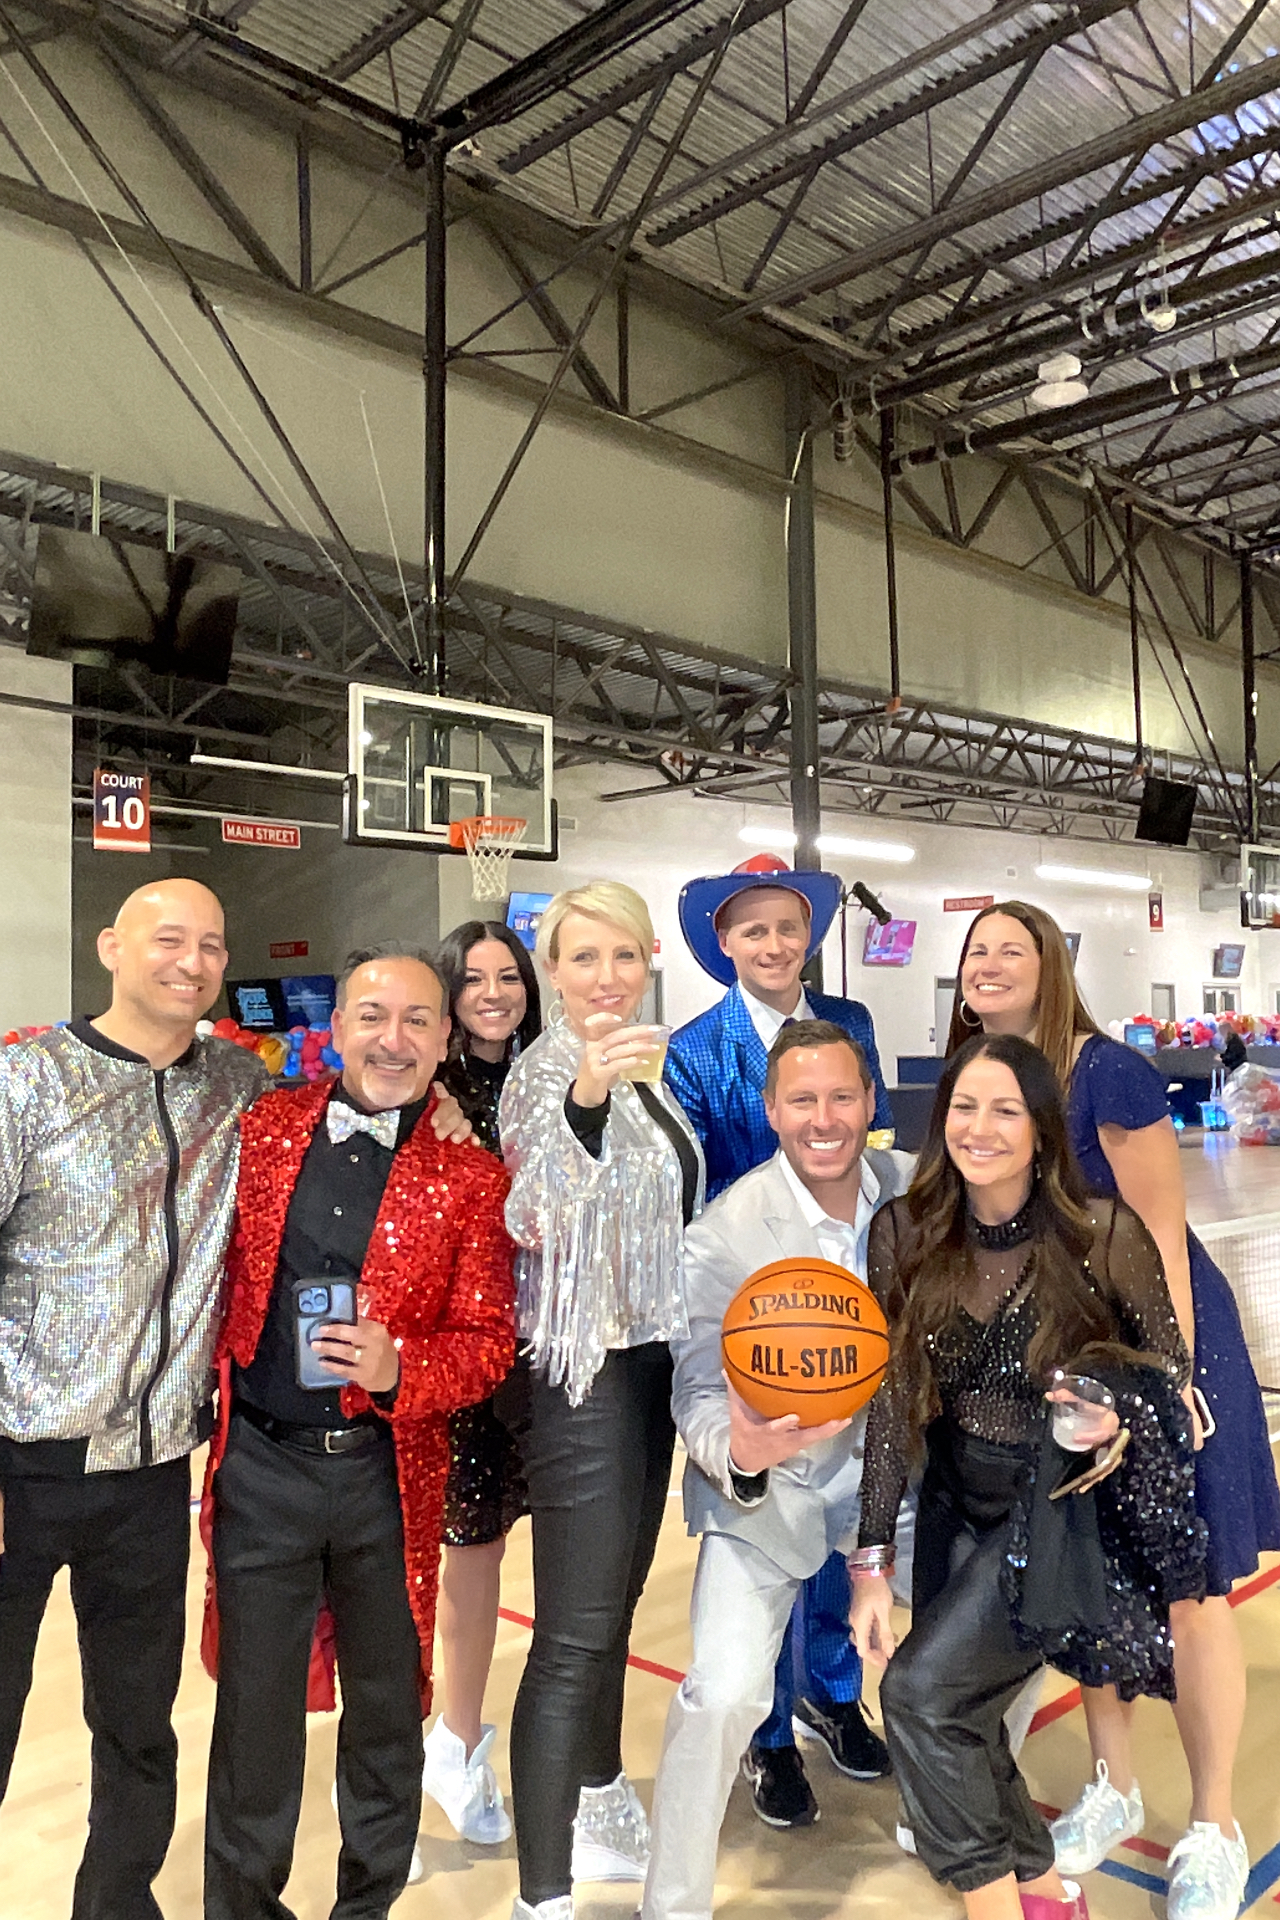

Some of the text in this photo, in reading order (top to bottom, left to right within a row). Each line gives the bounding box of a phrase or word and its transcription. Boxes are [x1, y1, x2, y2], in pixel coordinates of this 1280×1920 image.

[100, 773, 144, 790] COURT
[101, 795, 145, 830] 10
[226, 823, 296, 843] MAIN STREET
[1152, 904, 1160, 922] 9
[748, 1292, 863, 1324] SPALDING
[750, 1343, 858, 1379] ALL-STAR
